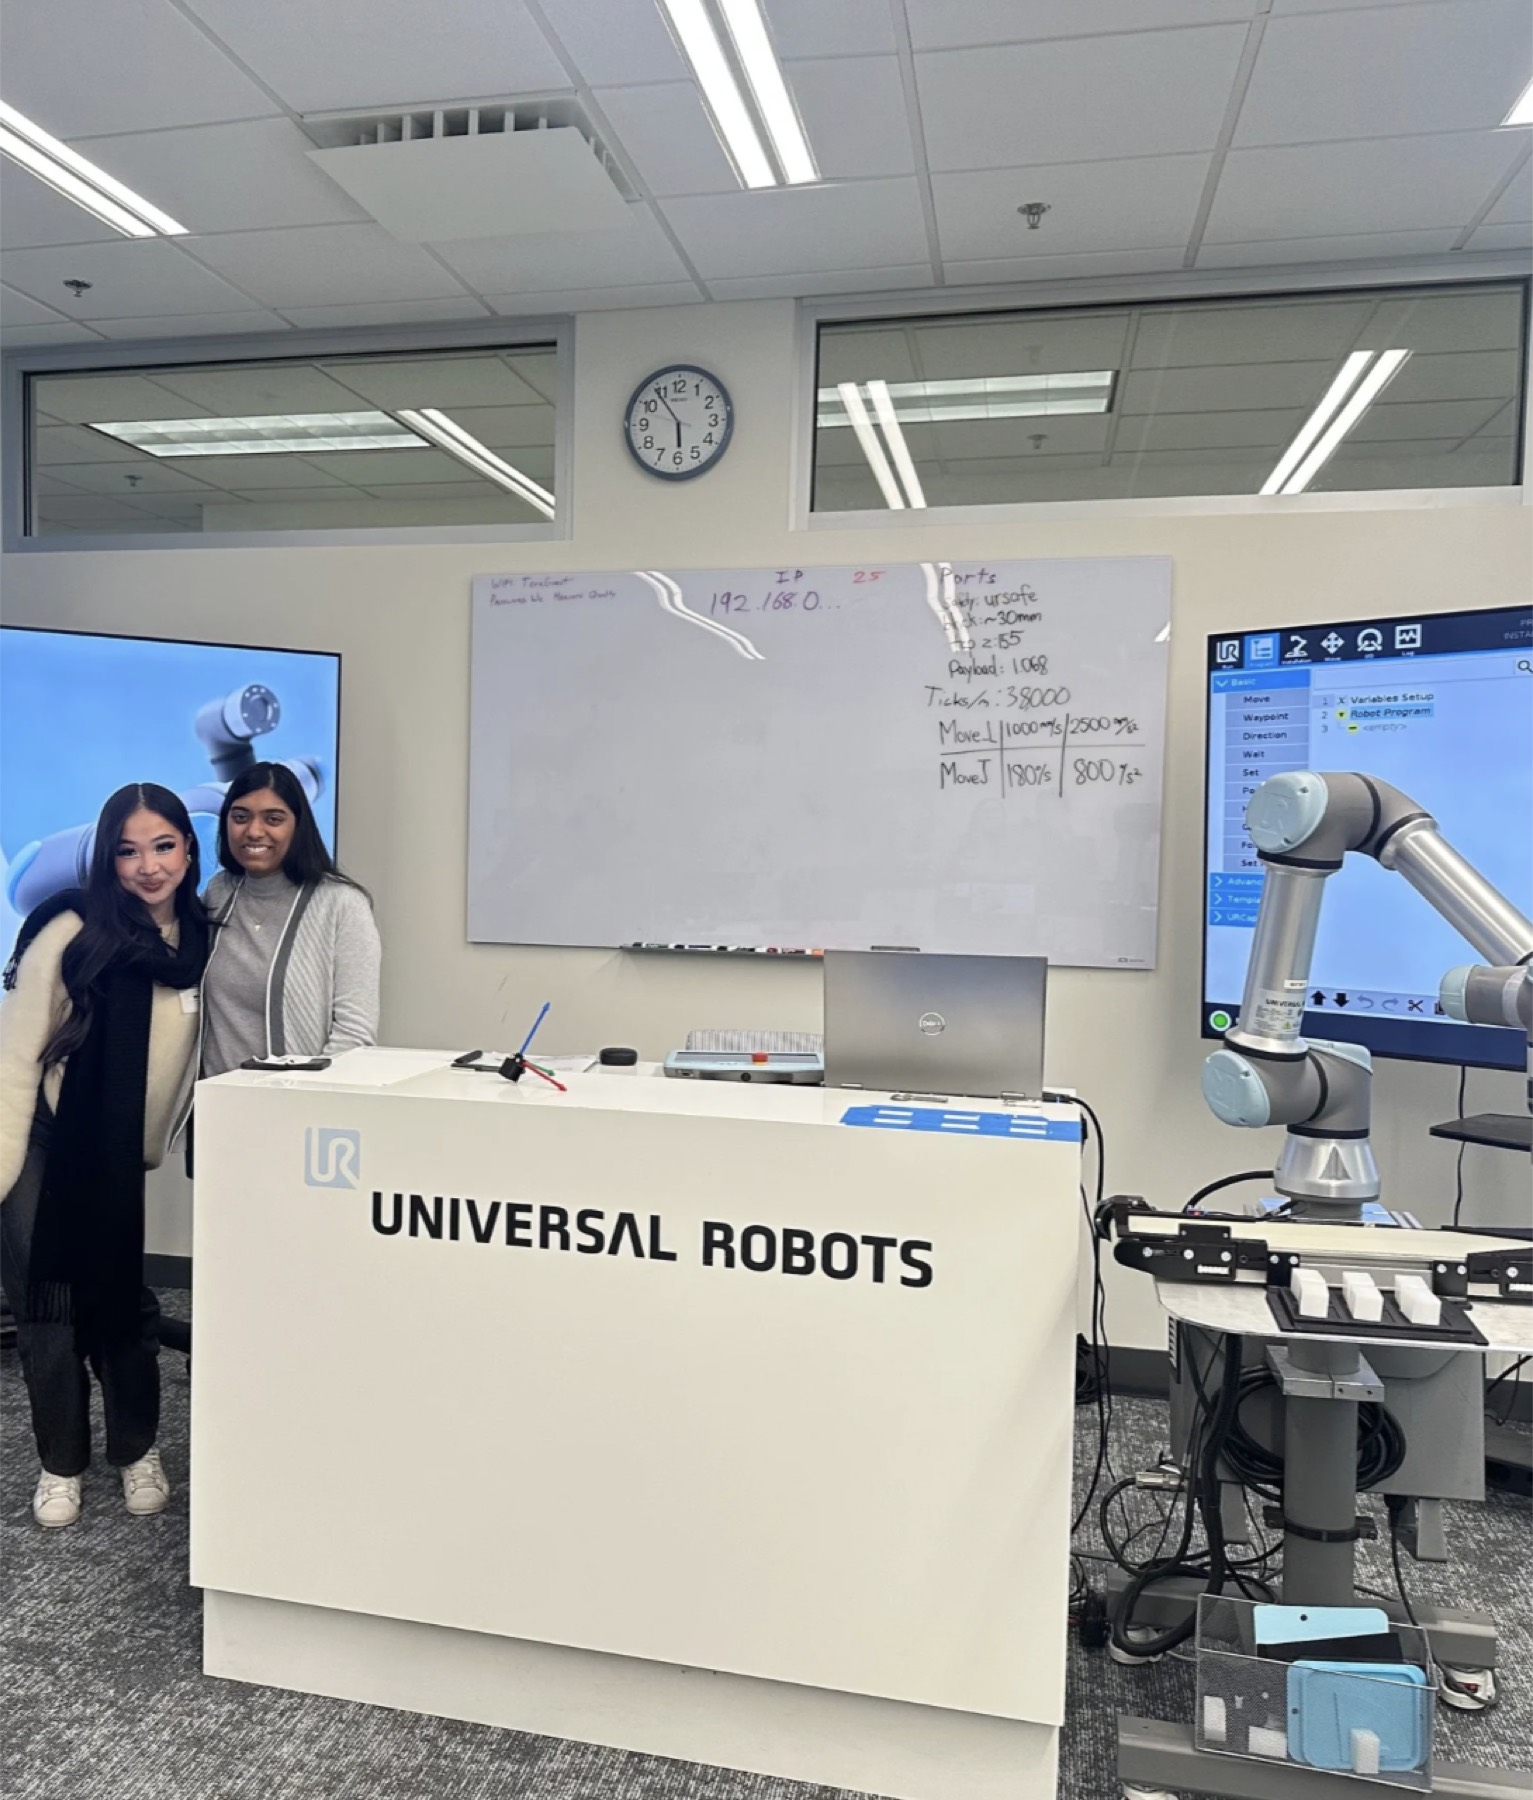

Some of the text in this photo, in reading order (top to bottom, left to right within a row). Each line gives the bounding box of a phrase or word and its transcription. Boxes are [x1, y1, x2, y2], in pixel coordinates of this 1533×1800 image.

[672, 380, 687, 393] 12
[694, 383, 700, 396] 1
[643, 400, 658, 413] 10
[704, 395, 714, 409] 2
[640, 418, 649, 431] 9
[708, 413, 719, 427] 3
[644, 436, 654, 449] 8
[703, 432, 713, 446] 4
[656, 448, 665, 461] 7
[673, 451, 683, 464] 6
[690, 446, 700, 459] 5
[775, 570, 804, 584] IP
[852, 570, 888, 584] 25
[940, 567, 996, 584] Ports
[1231, 678, 1256, 687] Basic
[1243, 696, 1270, 704] Move
[1350, 695, 1399, 704] Variables
[1402, 693, 1434, 704] Setup
[1243, 712, 1289, 724] Waypoint
[1350, 709, 1382, 718] Robot
[1383, 708, 1431, 719] Program
[1242, 731, 1288, 741] Direction
[1242, 750, 1265, 759] Wait
[939, 758, 992, 790] MoveJ
[1242, 768, 1260, 777] Set
[1241, 859, 1258, 868] Set
[1227, 877, 1263, 887] Advanc
[1227, 895, 1261, 906] Templa
[371, 1191, 934, 1288] UNIVERSAL ROBOTS
